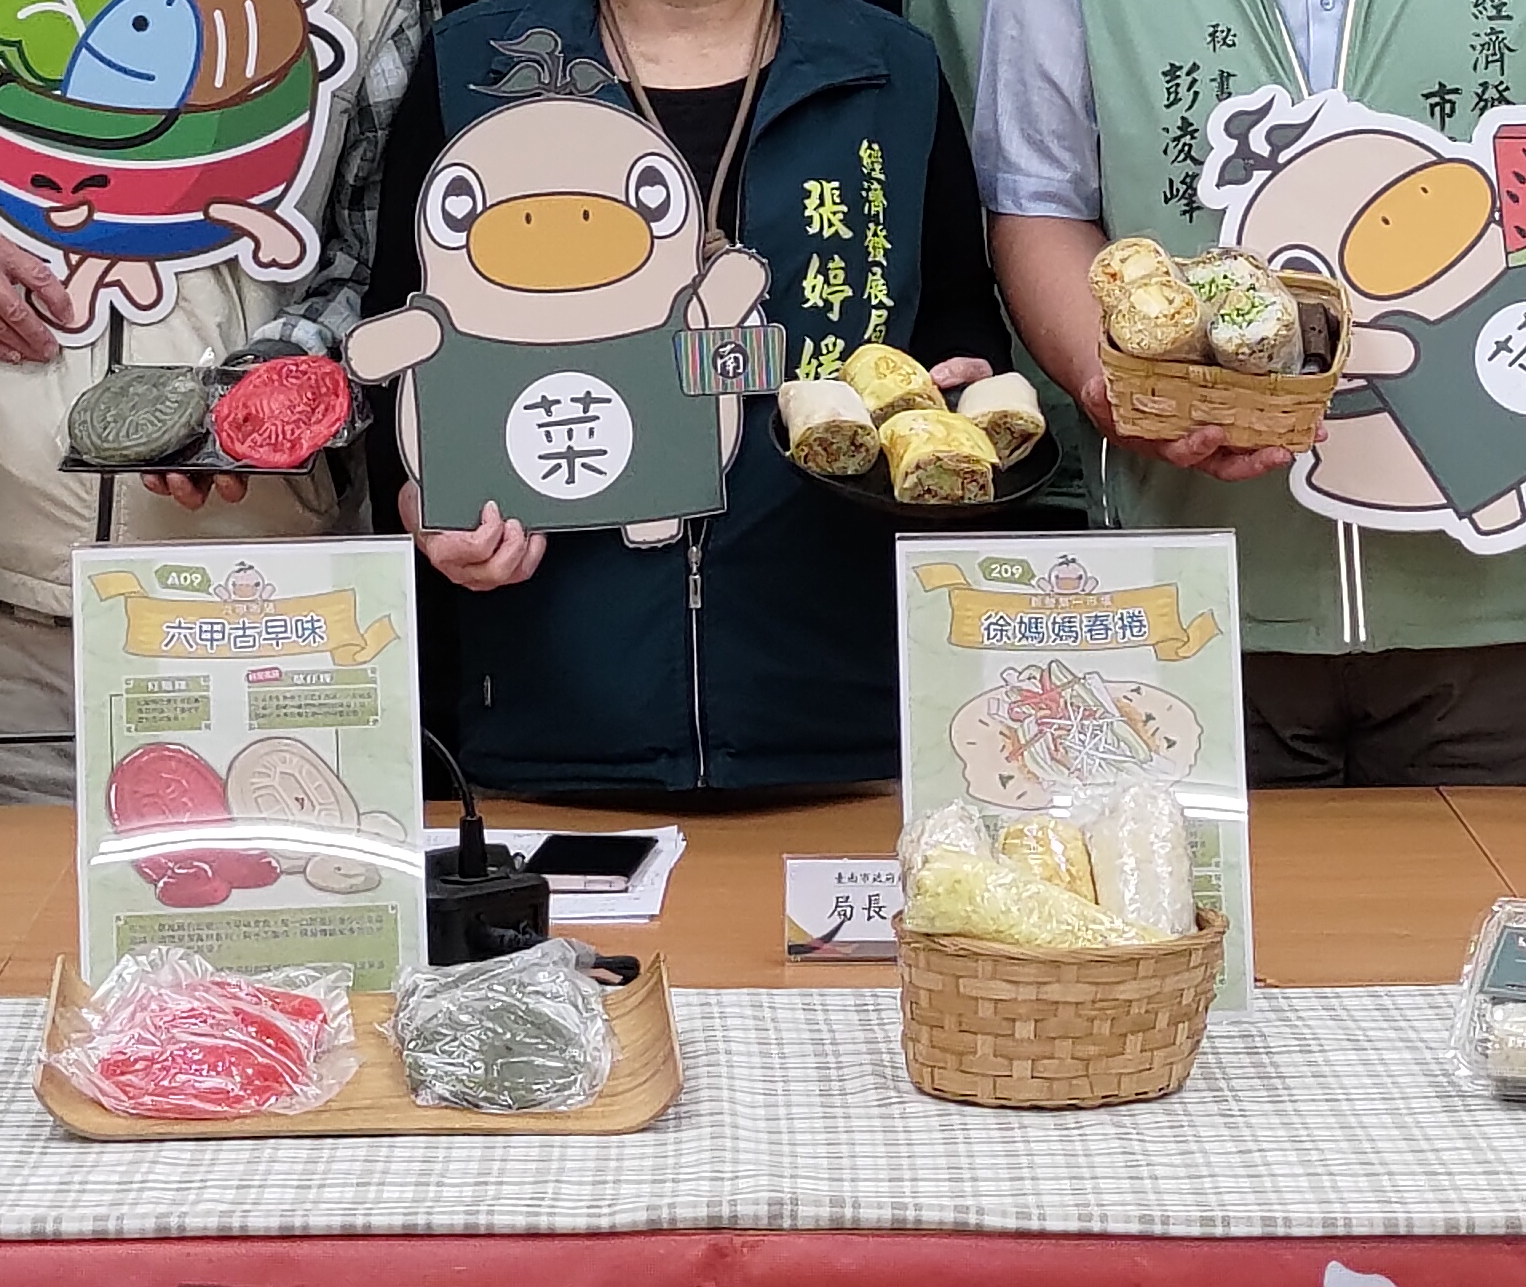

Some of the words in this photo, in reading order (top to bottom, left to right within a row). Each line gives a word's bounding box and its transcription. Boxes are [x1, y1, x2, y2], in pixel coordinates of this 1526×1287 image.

[1161, 61, 1205, 224] 彭凌峰
[715, 343, 744, 377] 南
[523, 390, 613, 485] 菜
[167, 572, 202, 588] A09
[990, 563, 1023, 579] 209
[162, 613, 327, 651] 六甲古早味
[980, 607, 1149, 645] 徐媽媽春捲
[827, 893, 888, 922] 局長
